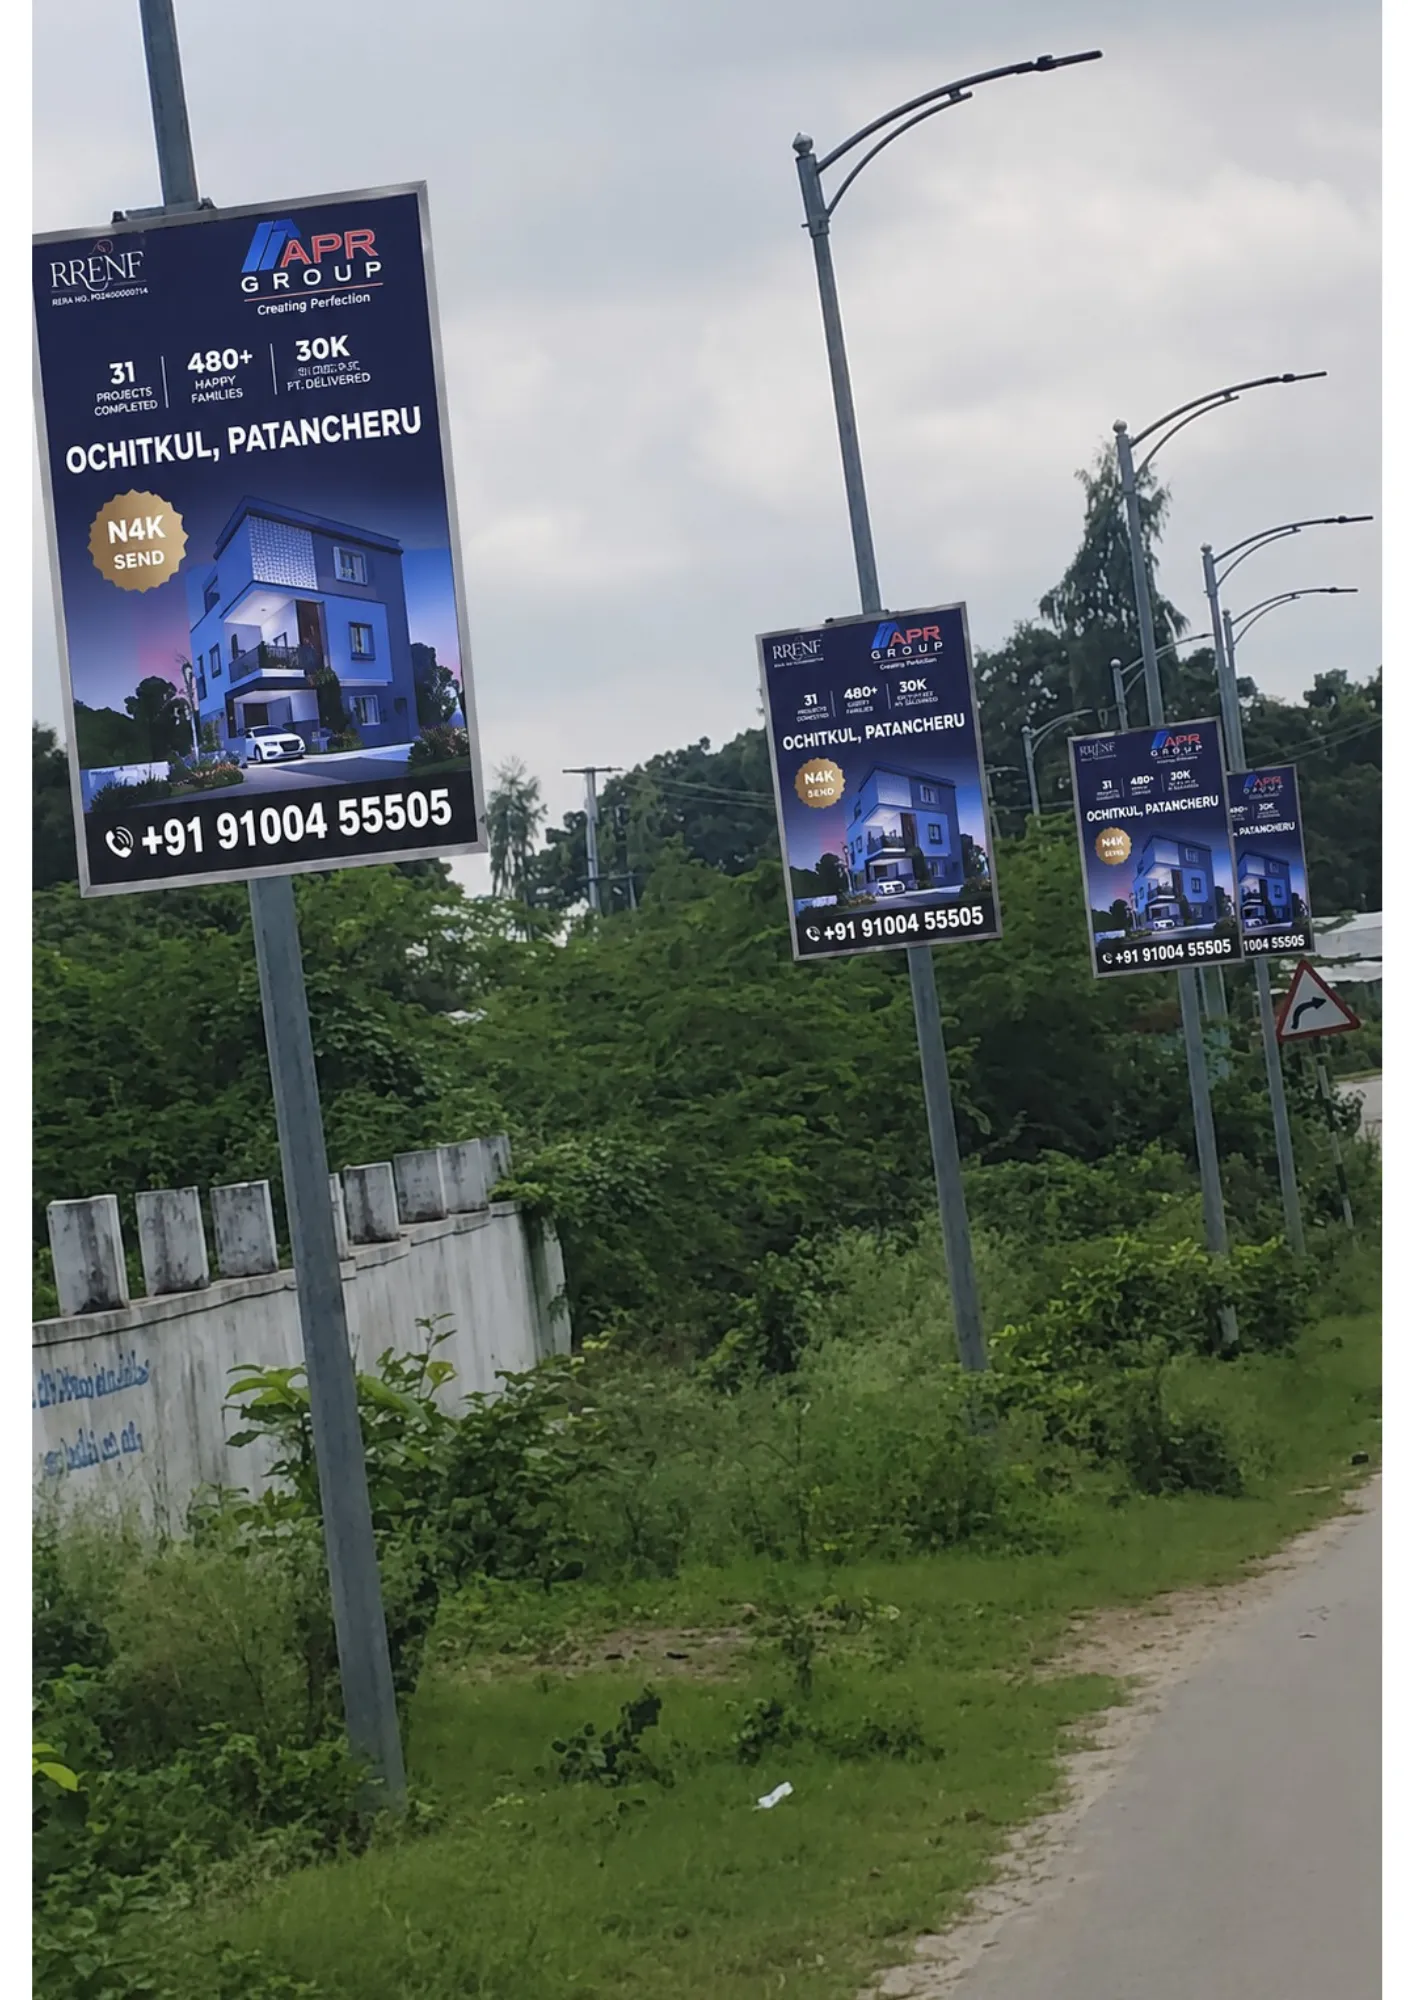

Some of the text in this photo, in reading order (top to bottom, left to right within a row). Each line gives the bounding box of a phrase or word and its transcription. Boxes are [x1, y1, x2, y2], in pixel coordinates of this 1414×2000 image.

[280, 229, 379, 268] APR
[50, 251, 144, 291] RRENF
[241, 261, 382, 293] GROUP
[257, 293, 371, 315] Creating Perfection
[295, 335, 350, 361] 30K
[187, 348, 253, 374] 480+
[109, 361, 135, 384] 31
[195, 375, 236, 390] HAPPY
[306, 372, 371, 389] DELIVERED
[96, 387, 153, 402] PROJECTS
[65, 405, 422, 474] OCHITKUL, PATANCHERU
[107, 515, 166, 544] N4K
[113, 550, 165, 570] SEND
[890, 625, 941, 647] APR
[871, 640, 943, 660] GROUP
[843, 686, 878, 700] 480+
[899, 678, 927, 693] 30K
[803, 693, 818, 706] 31
[782, 712, 966, 751] OCHITKUL, PATANCHERU
[1165, 733, 1201, 747] APR
[804, 770, 834, 784] N4K
[1086, 795, 1220, 822] OCHITKUL, PATANCHERU
[141, 788, 452, 856] +91 91004 55505
[824, 905, 984, 941] +91 91004 55505
[1115, 938, 1232, 964] +91 91004 55505
[1243, 934, 1305, 951] 1004 55505
